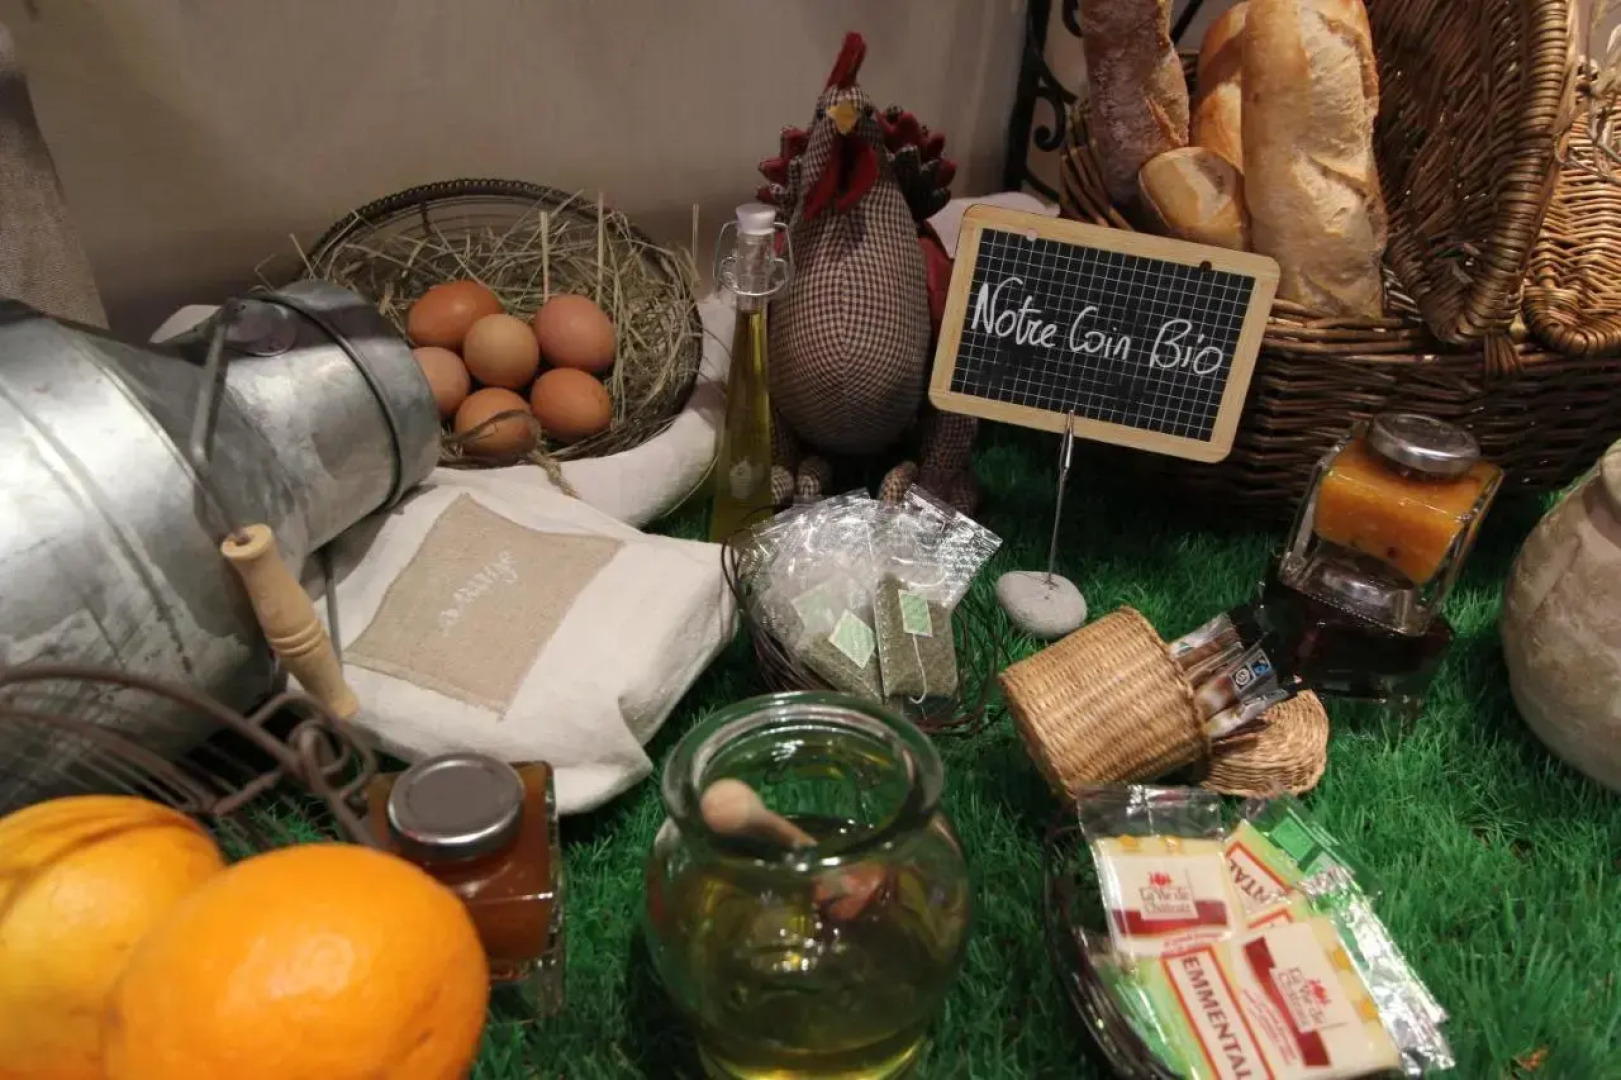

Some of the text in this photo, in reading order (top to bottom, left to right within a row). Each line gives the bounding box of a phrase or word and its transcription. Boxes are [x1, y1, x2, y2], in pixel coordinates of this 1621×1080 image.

[971, 277, 1223, 375] Notre Coin Bio
[1182, 955, 1252, 1080] EMMENTAL
